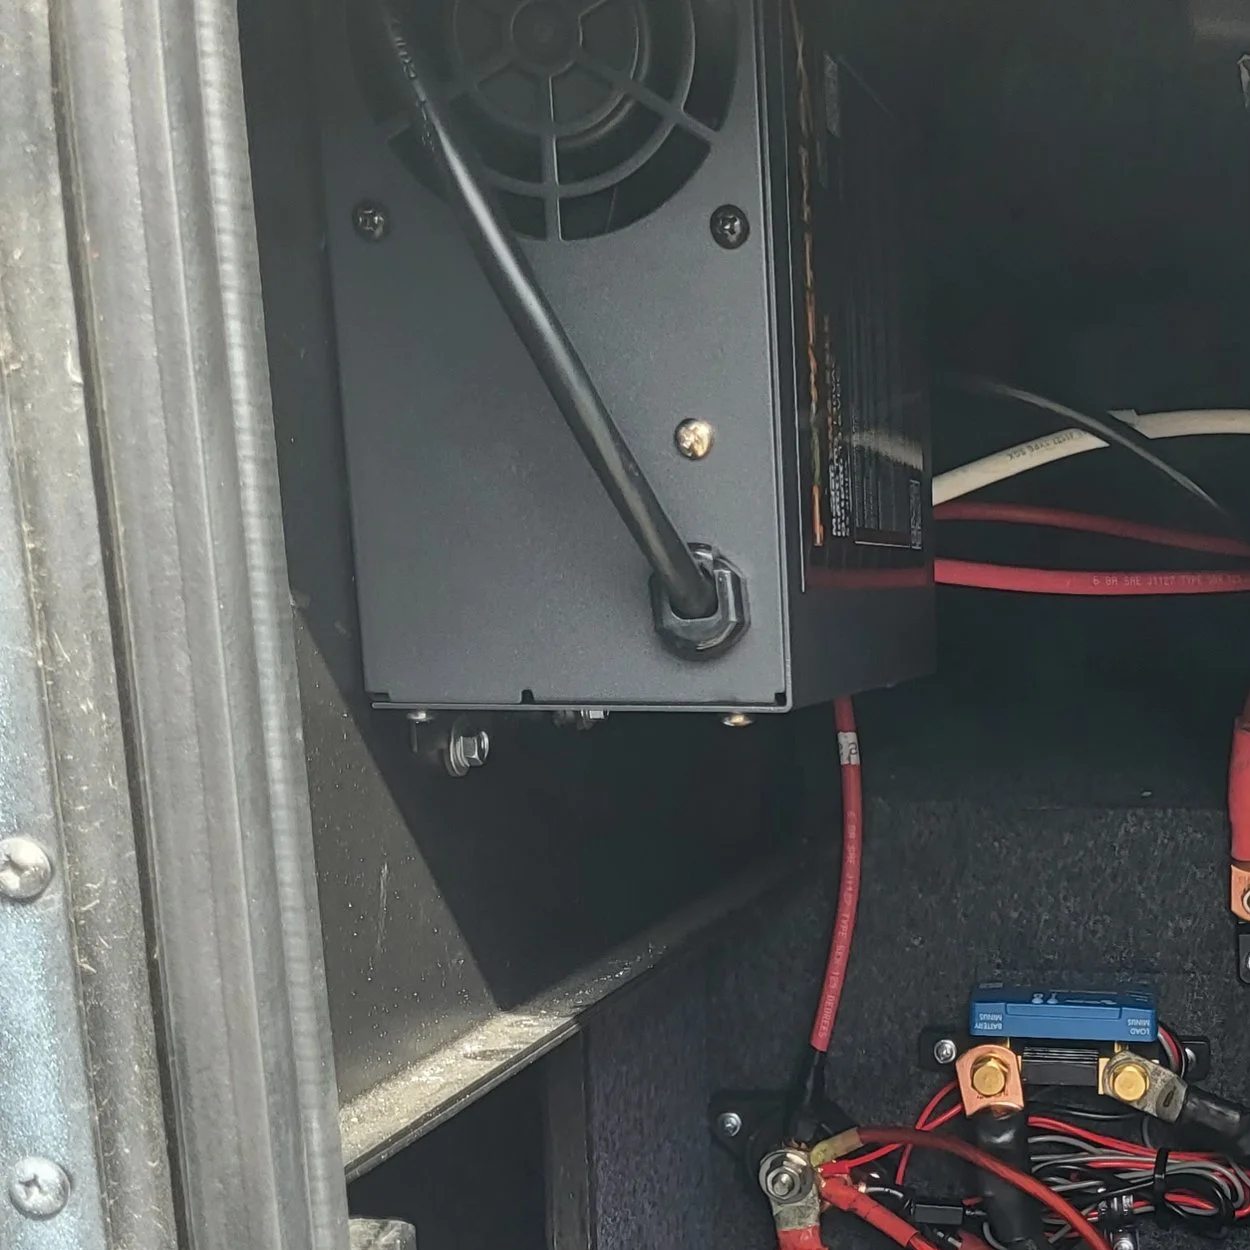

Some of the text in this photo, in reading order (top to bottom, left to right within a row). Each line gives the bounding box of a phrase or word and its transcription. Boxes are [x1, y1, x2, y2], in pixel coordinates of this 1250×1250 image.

[1123, 575, 1142, 586] SAE
[838, 913, 850, 939] TYPE
[818, 995, 838, 1039] DEGREES
[978, 1013, 1003, 1022] MINUS
[974, 1022, 1003, 1031] BATTERY
[1127, 1018, 1150, 1027] MINUS
[1129, 1027, 1151, 1036] LOAD
